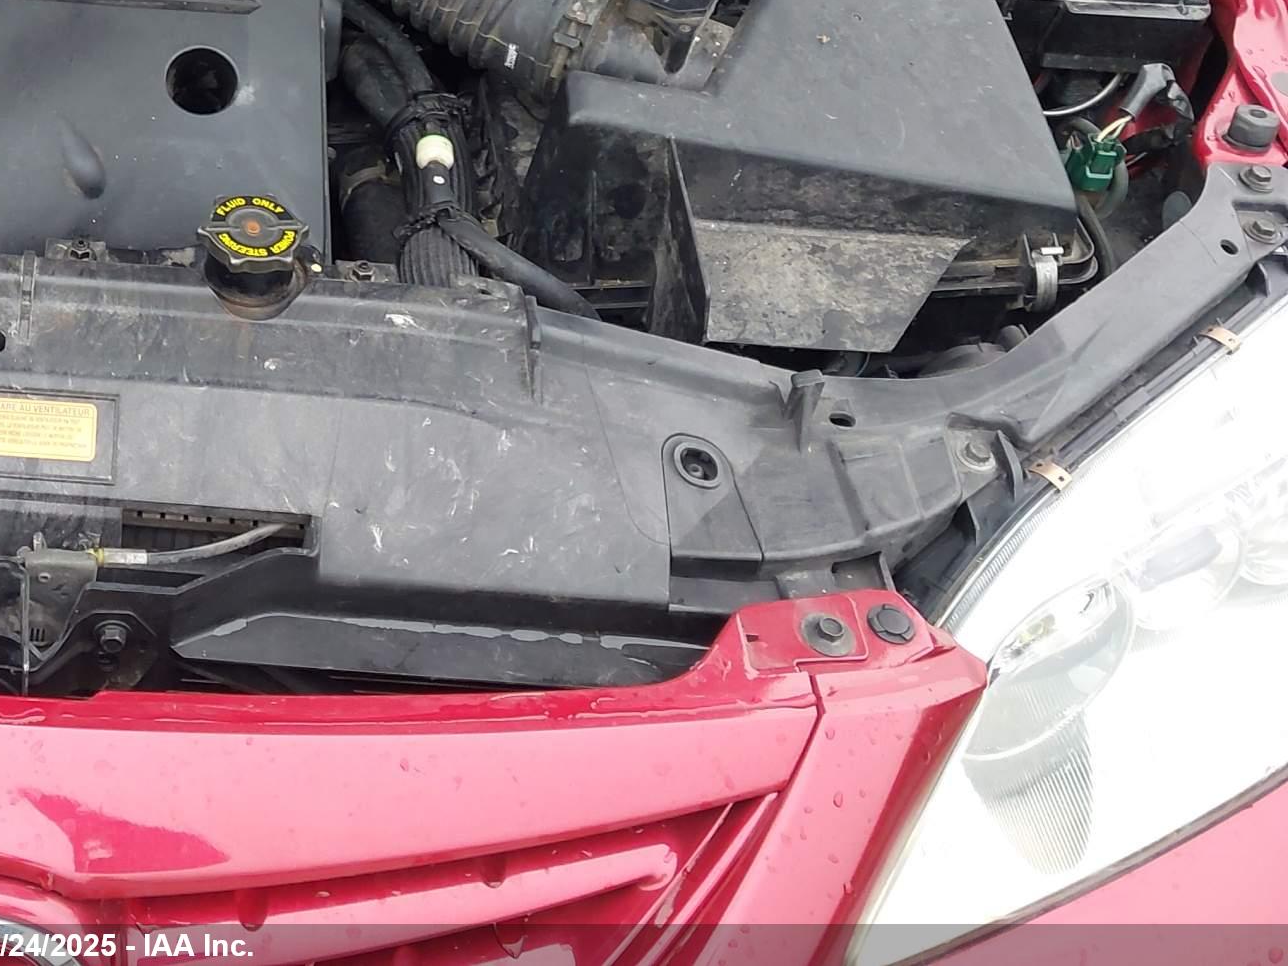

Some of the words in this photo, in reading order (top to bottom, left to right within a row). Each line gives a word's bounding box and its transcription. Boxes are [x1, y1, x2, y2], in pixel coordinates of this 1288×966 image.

[216, 197, 247, 216] FLUID
[252, 197, 285, 214] ONLY
[218, 233, 269, 257] STEERING
[269, 230, 295, 254] POWER
[19, 403, 32, 412] AU
[33, 404, 90, 417] VENTILATEUR
